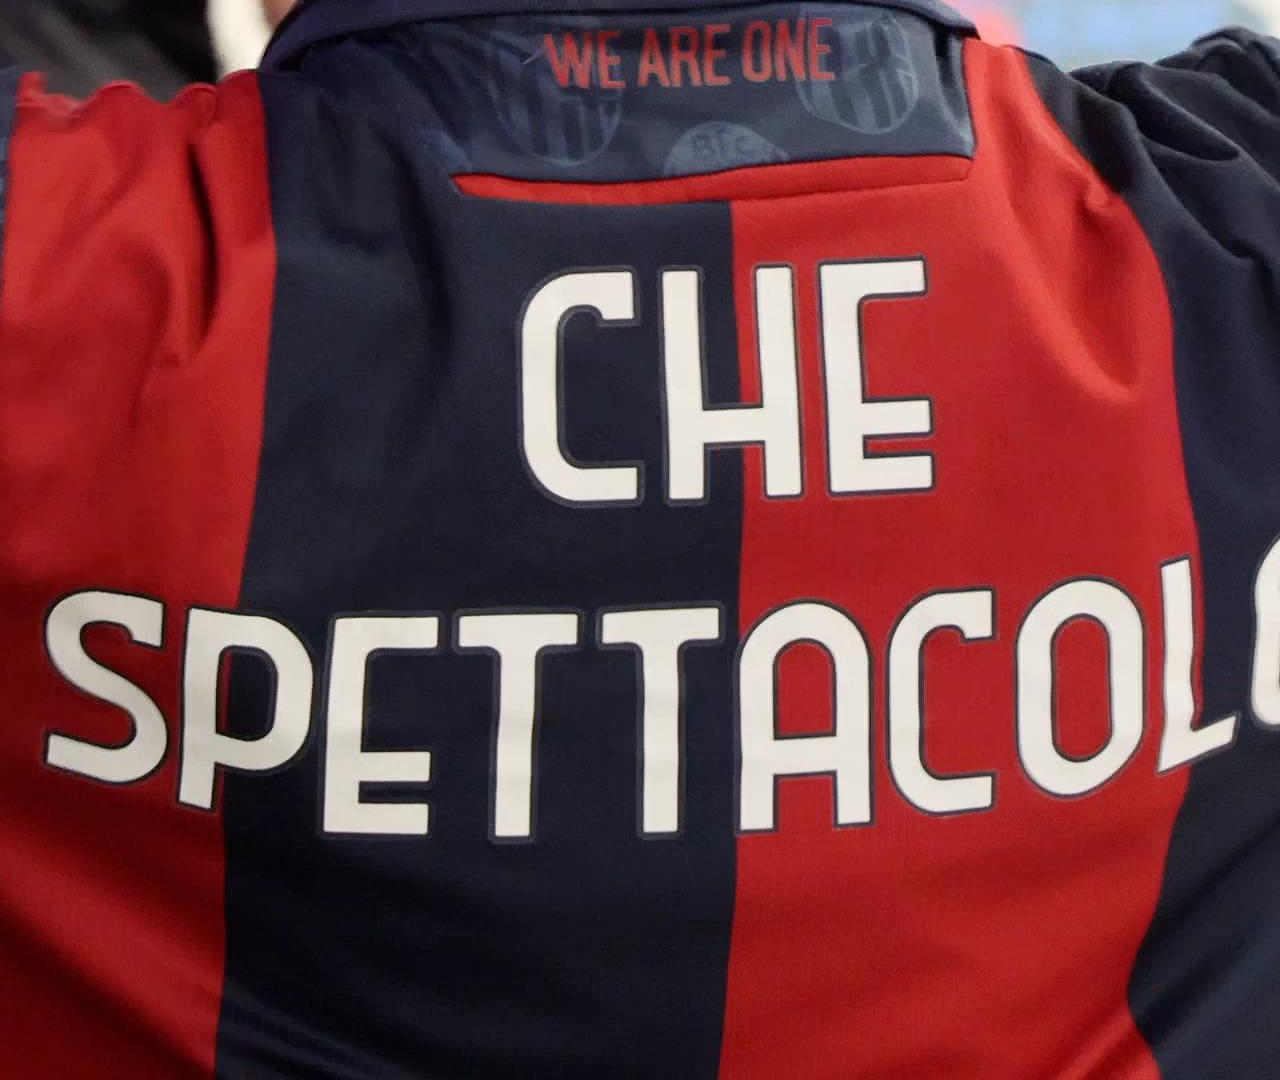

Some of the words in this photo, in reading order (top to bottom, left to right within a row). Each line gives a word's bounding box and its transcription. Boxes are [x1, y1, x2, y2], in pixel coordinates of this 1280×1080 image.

[542, 27, 626, 90] WE
[637, 22, 731, 89] ARE
[741, 16, 836, 84] ONE
[521, 258, 935, 503] CHE
